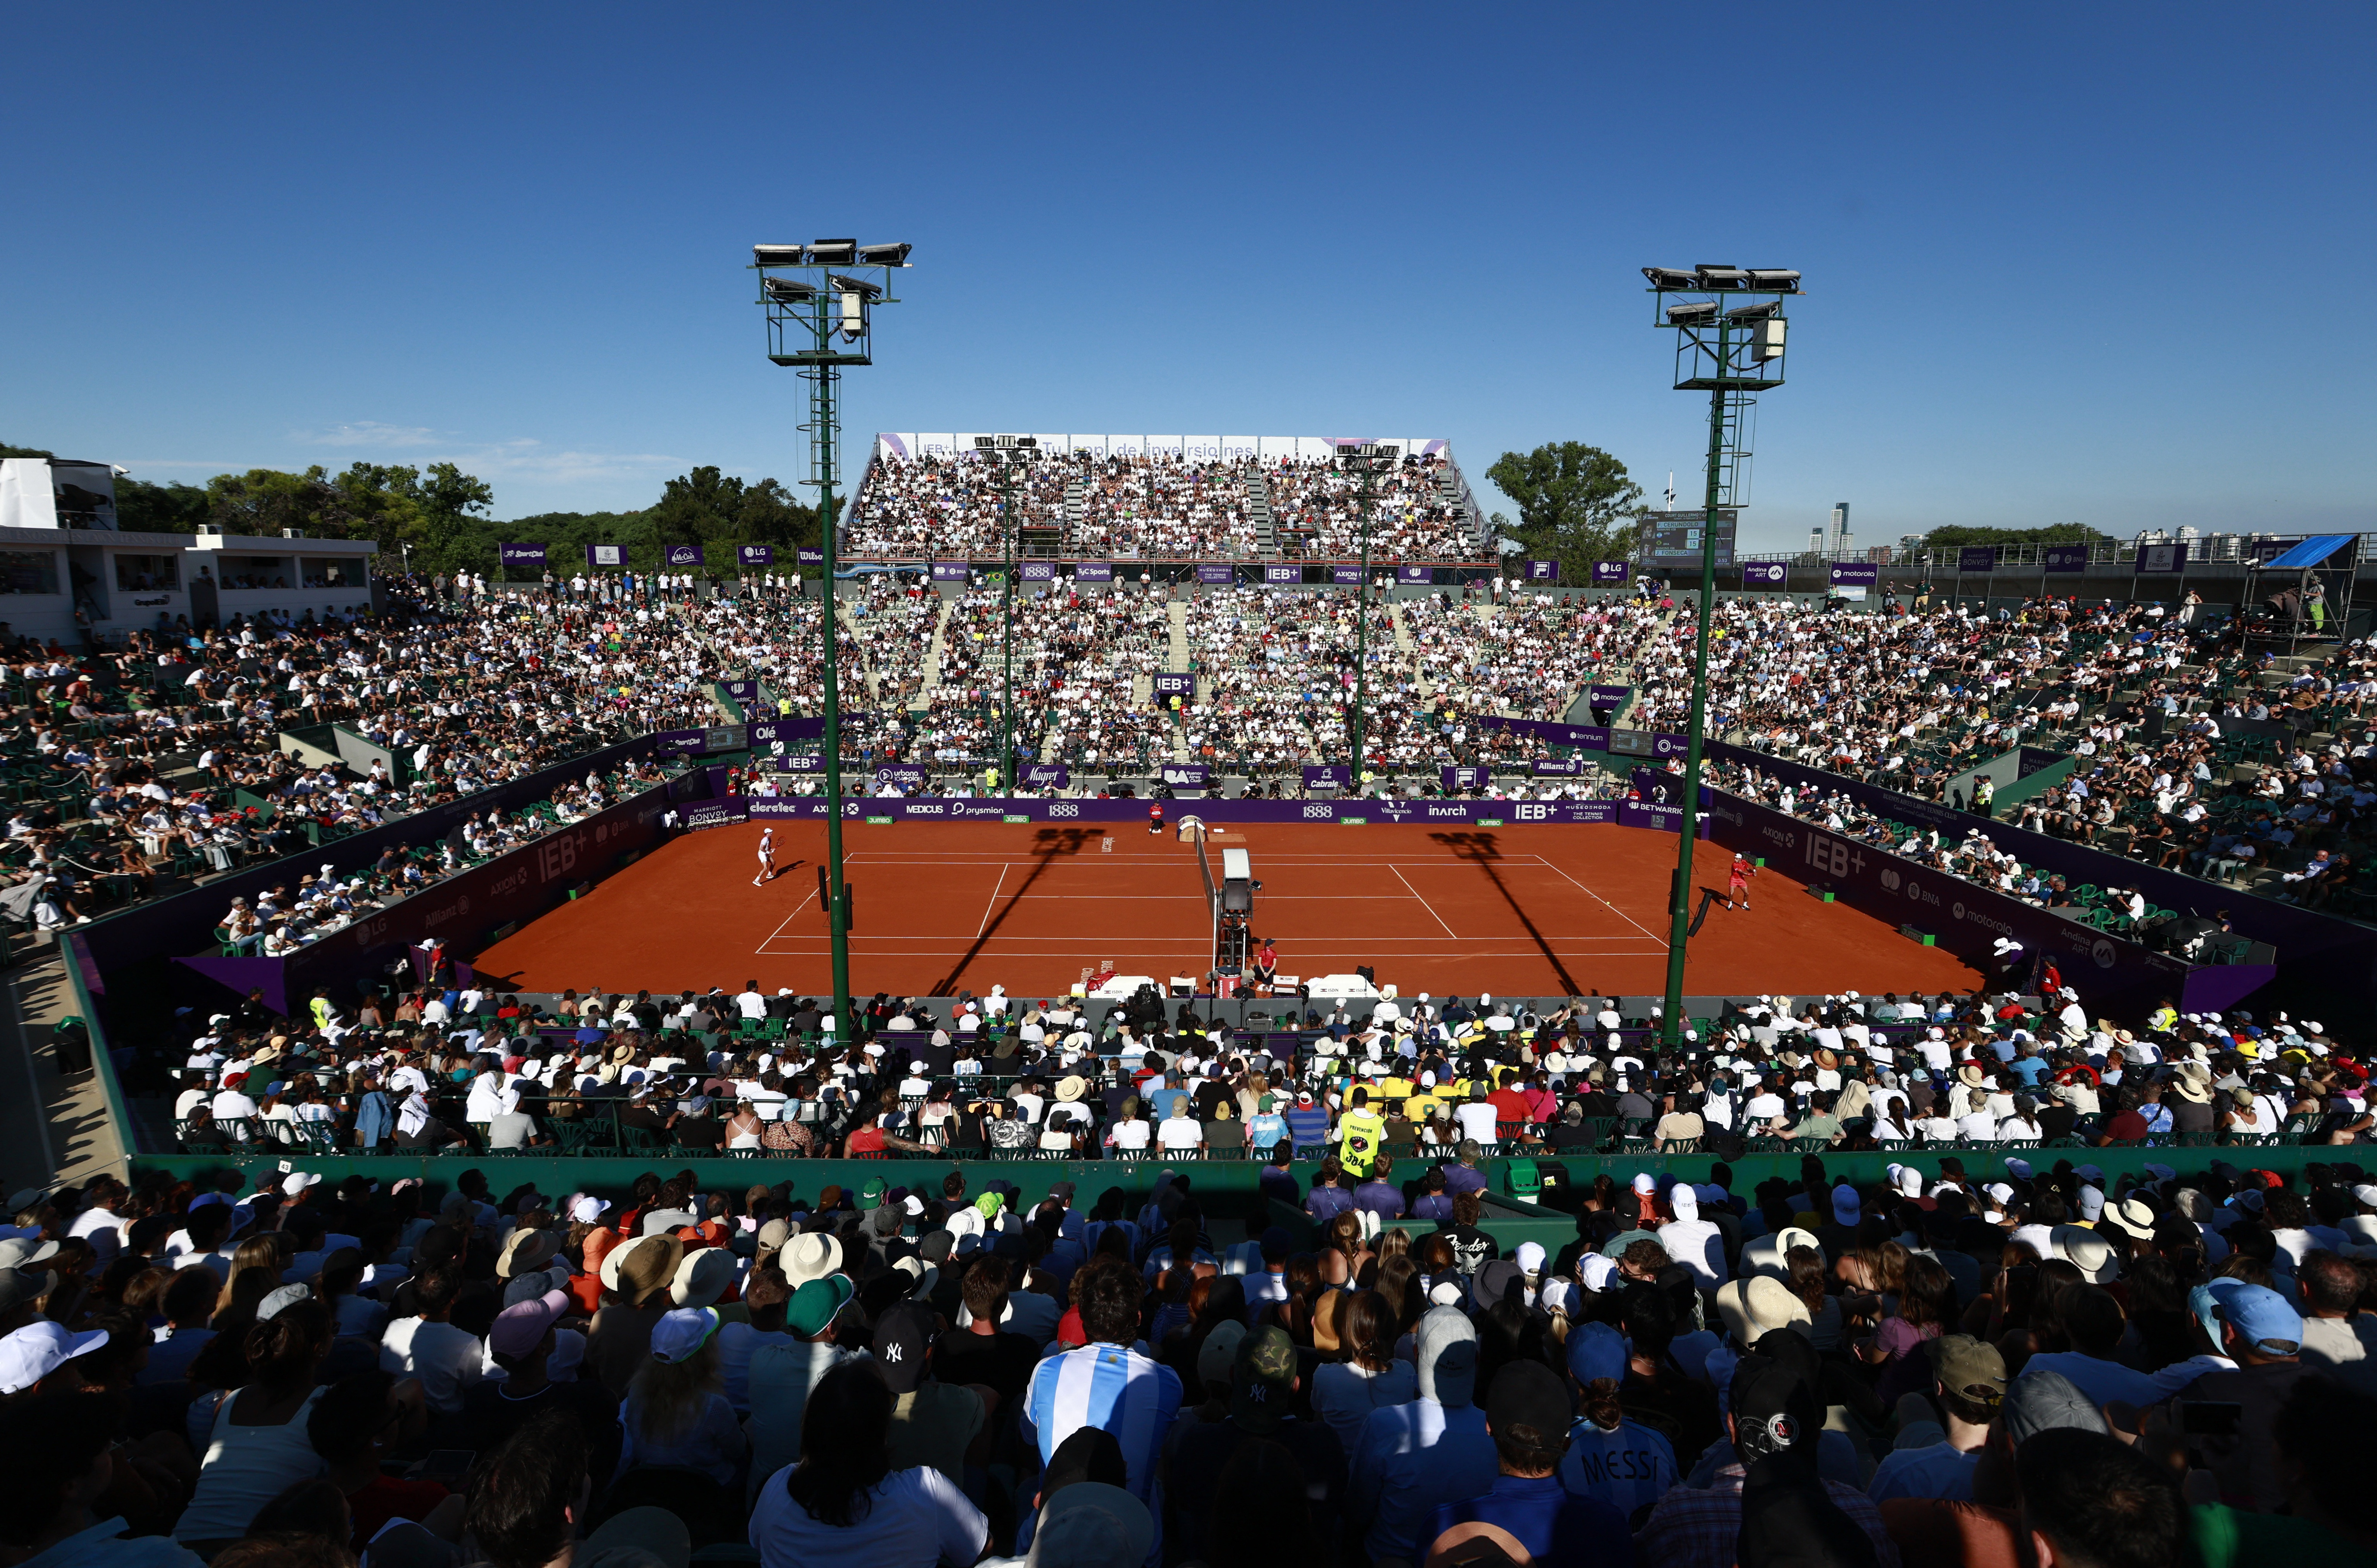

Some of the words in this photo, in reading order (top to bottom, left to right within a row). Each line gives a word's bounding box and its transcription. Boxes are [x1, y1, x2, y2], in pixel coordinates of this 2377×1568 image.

[1042, 442, 1061, 456] Tu
[1118, 443, 1137, 456] de
[675, 553, 695, 561] McCain
[799, 551, 823, 560] Wilso
[1025, 566, 1050, 577] 1888
[1268, 569, 1298, 579] IEB+
[1157, 678, 1190, 690] IEB+
[756, 726, 776, 739] Olé
[1577, 733, 1603, 741] tennium
[788, 758, 818, 768] IEB+
[1026, 767, 1060, 786] Magret
[694, 805, 722, 813] MARRIOTT
[906, 805, 944, 813] MEDICUS
[966, 807, 1004, 815] prysmian
[1049, 804, 1079, 816] 1888
[1303, 806, 1333, 818] 1888
[1515, 804, 1558, 820] IEB+
[1715, 805, 1735, 822] Allianz
[1883, 793, 1900, 804] BUENOS
[1900, 798, 1913, 808] AIRES
[1913, 802, 1927, 813] LAWN
[1927, 807, 1945, 817] TENNIS
[1944, 812, 1957, 821] CLUB
[689, 810, 726, 823] BONVOY
[1652, 814, 1665, 823] 152
[1762, 826, 1784, 842] AXION
[538, 834, 587, 884] IEB+
[1805, 831, 1866, 878] IEB+
[490, 874, 517, 897] AXION
[1921, 890, 1940, 907] BNA
[425, 905, 457, 929] Allianz
[1967, 910, 2013, 937] motorola
[371, 917, 387, 936] LG
[1902, 928, 1922, 942] JUMBO
[2061, 928, 2091, 946] Andina
[2071, 943, 2090, 956] ART
[1349, 1125, 1373, 1134] PREVENCIÓN
[1345, 1150, 1365, 1168] 384
[1444, 1234, 1490, 1252] Fender
[1581, 1450, 1659, 1486] MESSI
